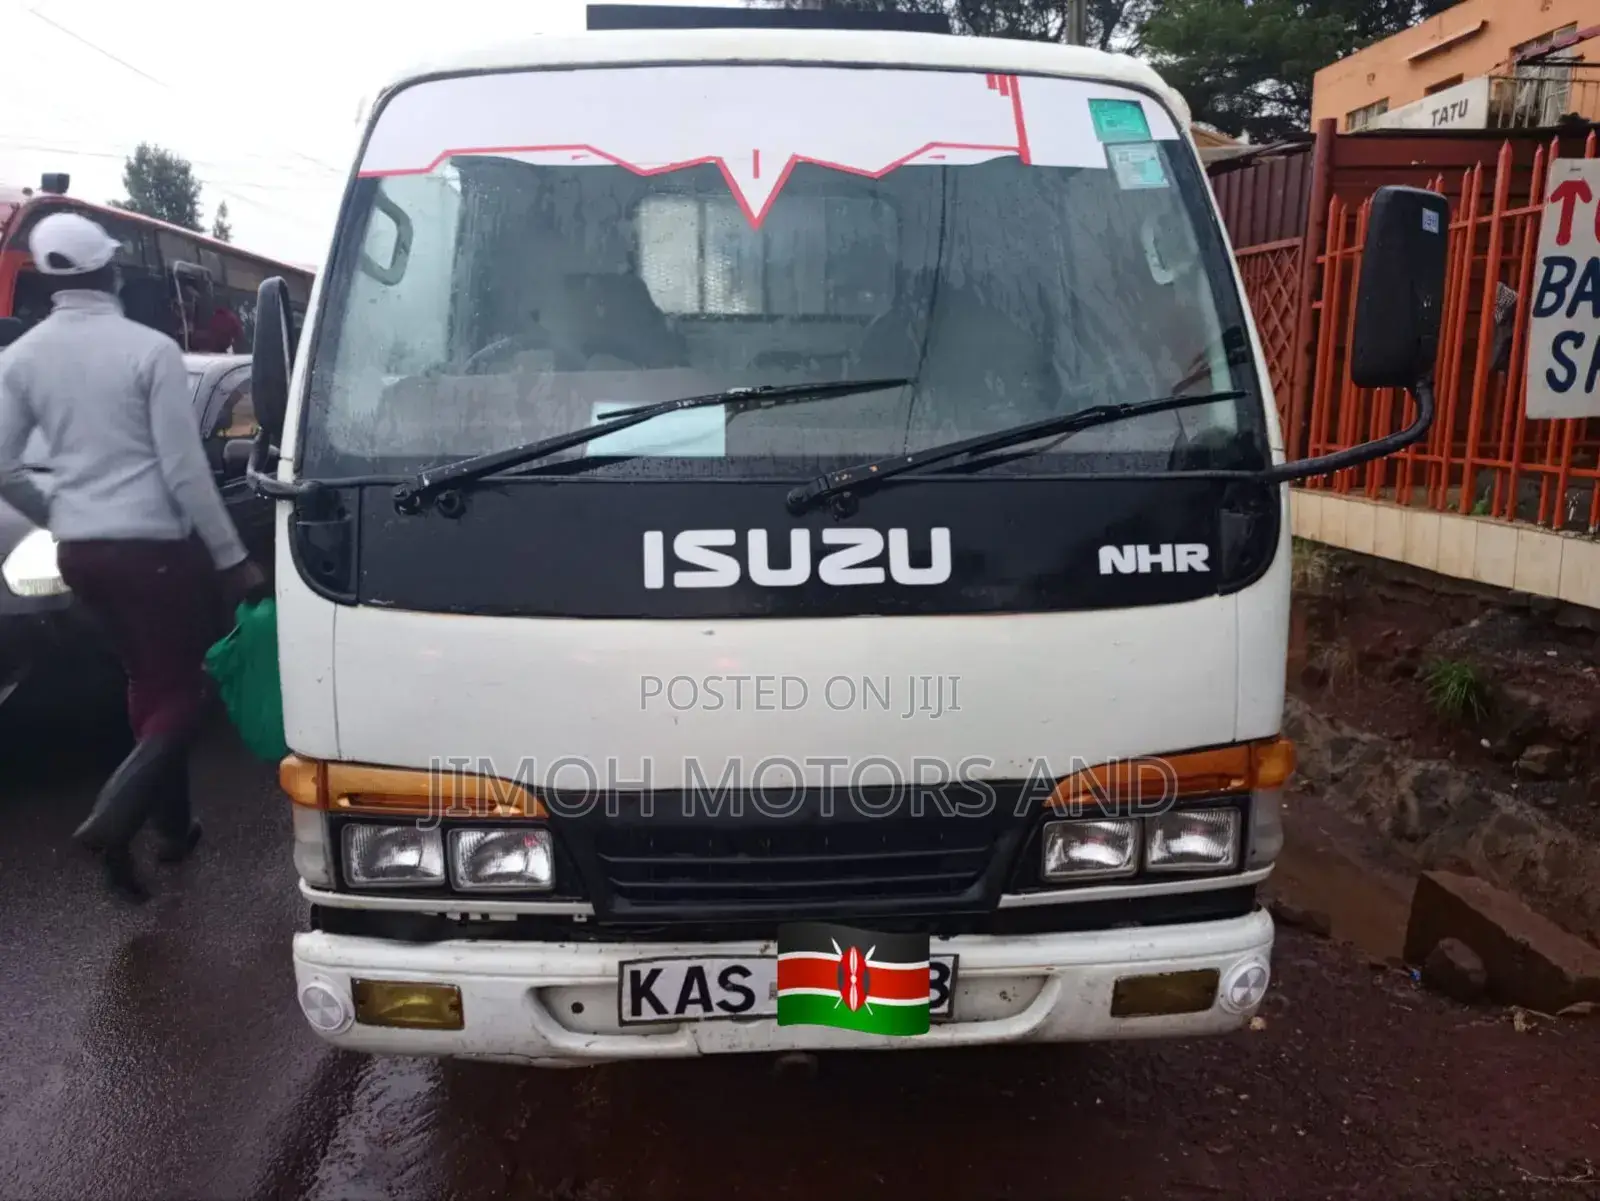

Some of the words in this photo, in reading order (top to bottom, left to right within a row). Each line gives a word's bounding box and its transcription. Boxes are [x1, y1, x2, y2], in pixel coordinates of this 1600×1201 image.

[1431, 97, 1469, 127] TATU
[643, 527, 952, 589] ISUZU
[1098, 543, 1211, 575] NHR
[629, 964, 756, 1017] KAS
